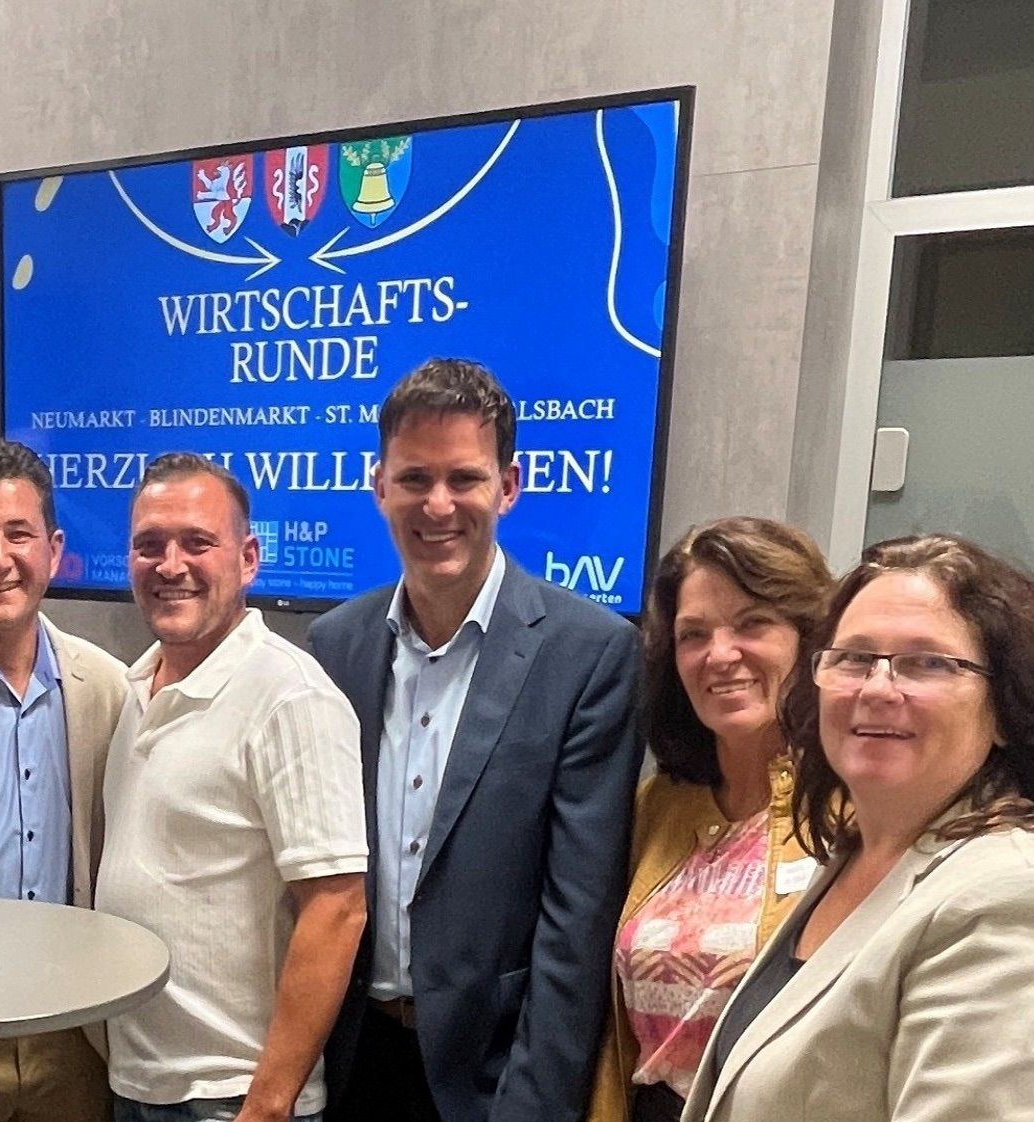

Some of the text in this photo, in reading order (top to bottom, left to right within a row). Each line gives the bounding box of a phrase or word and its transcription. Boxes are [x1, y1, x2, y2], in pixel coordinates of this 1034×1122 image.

[158, 275, 469, 336] WIRTSCHAFTS-
[229, 335, 379, 384] RUNDE
[31, 409, 137, 429] NEUMARKT
[149, 405, 311, 428] BLINDENMARKT
[325, 404, 353, 424] ST.
[513, 398, 616, 421] LSBACH
[284, 520, 328, 543] H&P
[283, 545, 355, 569] STONE
